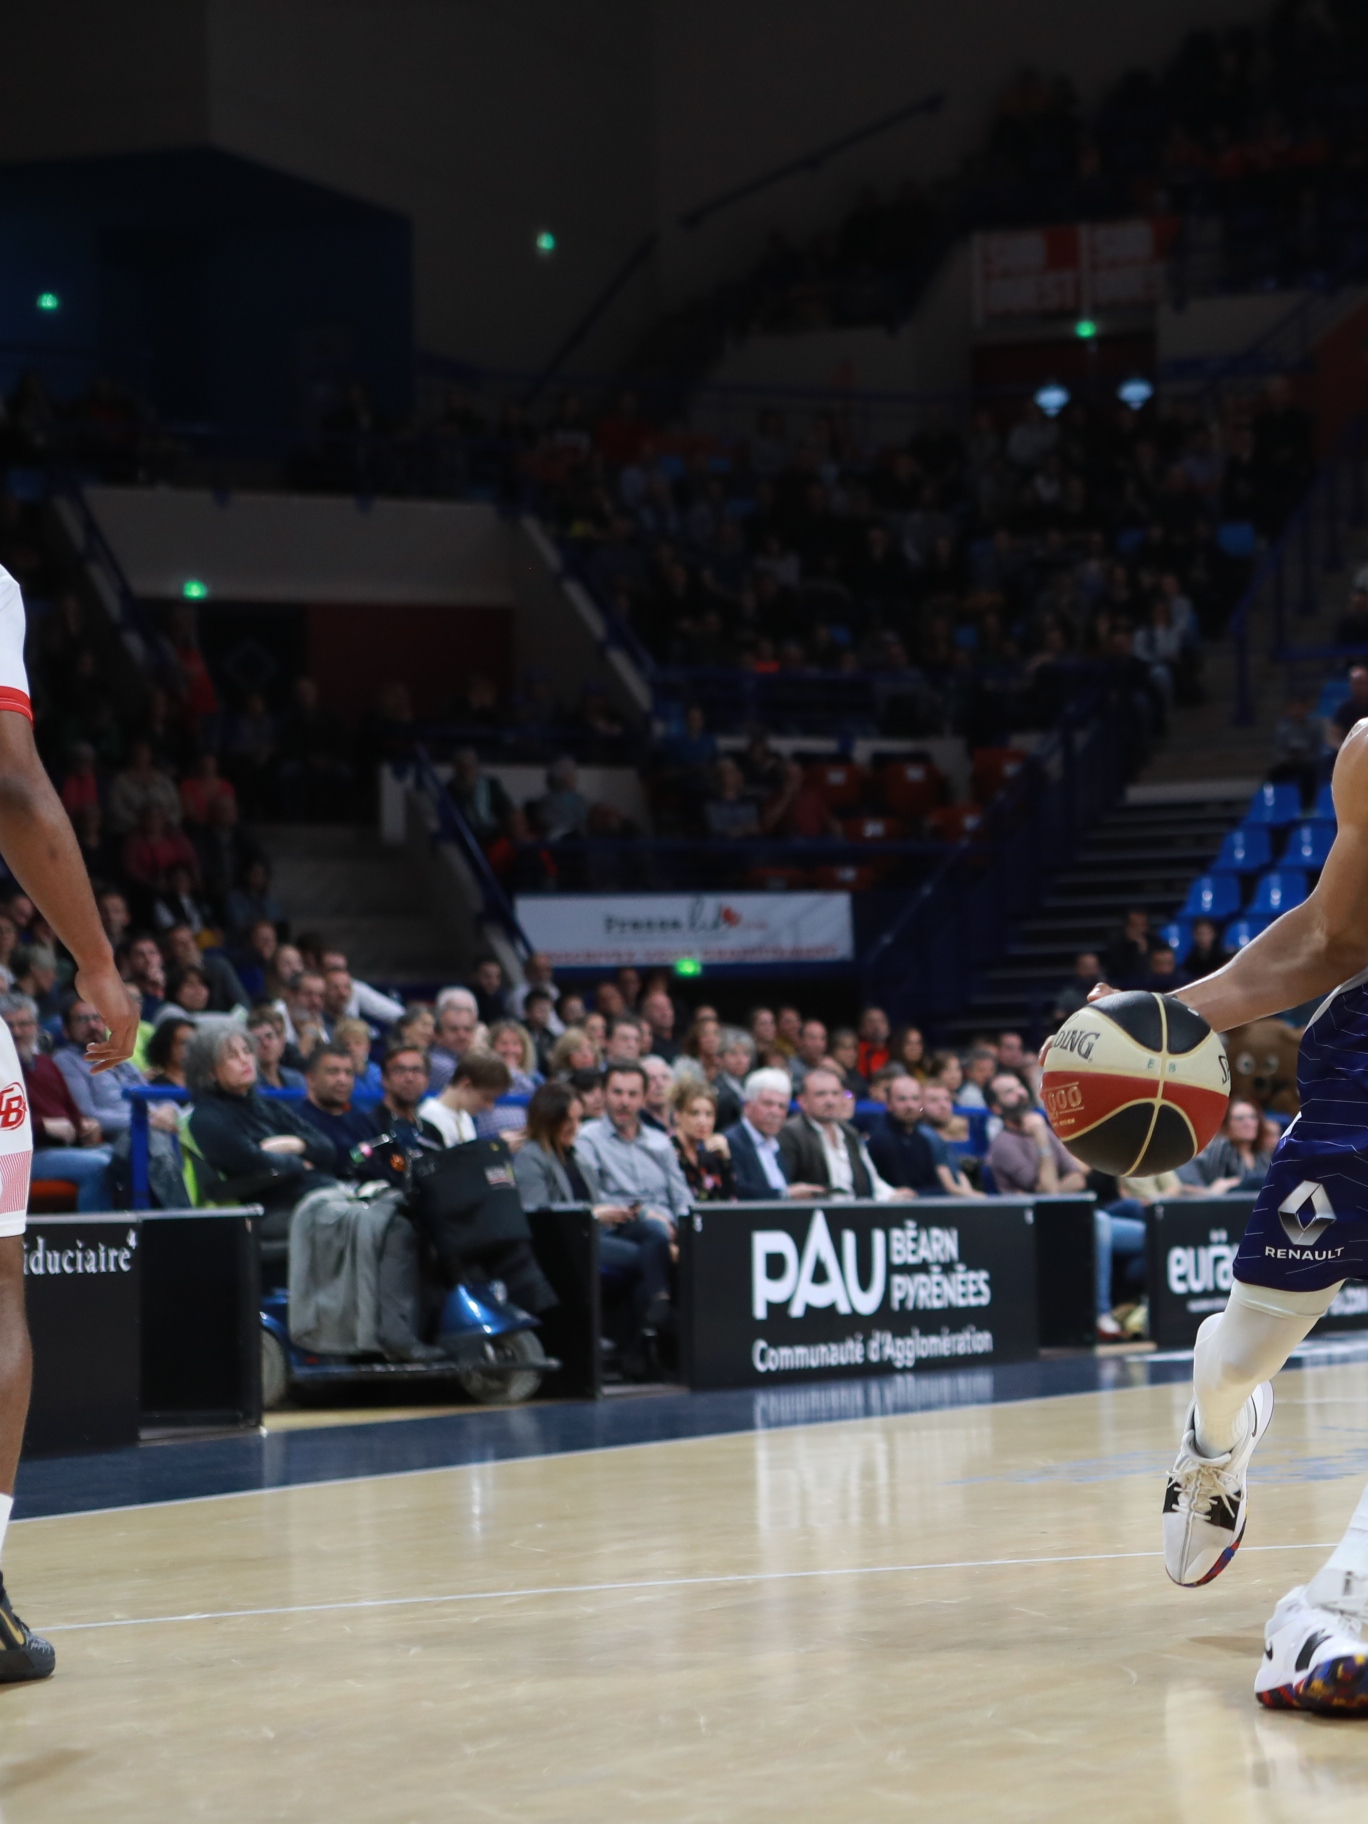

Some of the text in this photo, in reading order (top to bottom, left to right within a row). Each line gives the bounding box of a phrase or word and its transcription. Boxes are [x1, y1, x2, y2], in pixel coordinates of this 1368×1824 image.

[752, 1209, 886, 1320] PAU
[889, 1219, 959, 1266] BÉARN
[1264, 1245, 1345, 1262] RENAULT
[889, 1263, 992, 1312] PYRÉNÉES
[752, 1324, 993, 1373] Communauté d'Agglomération
